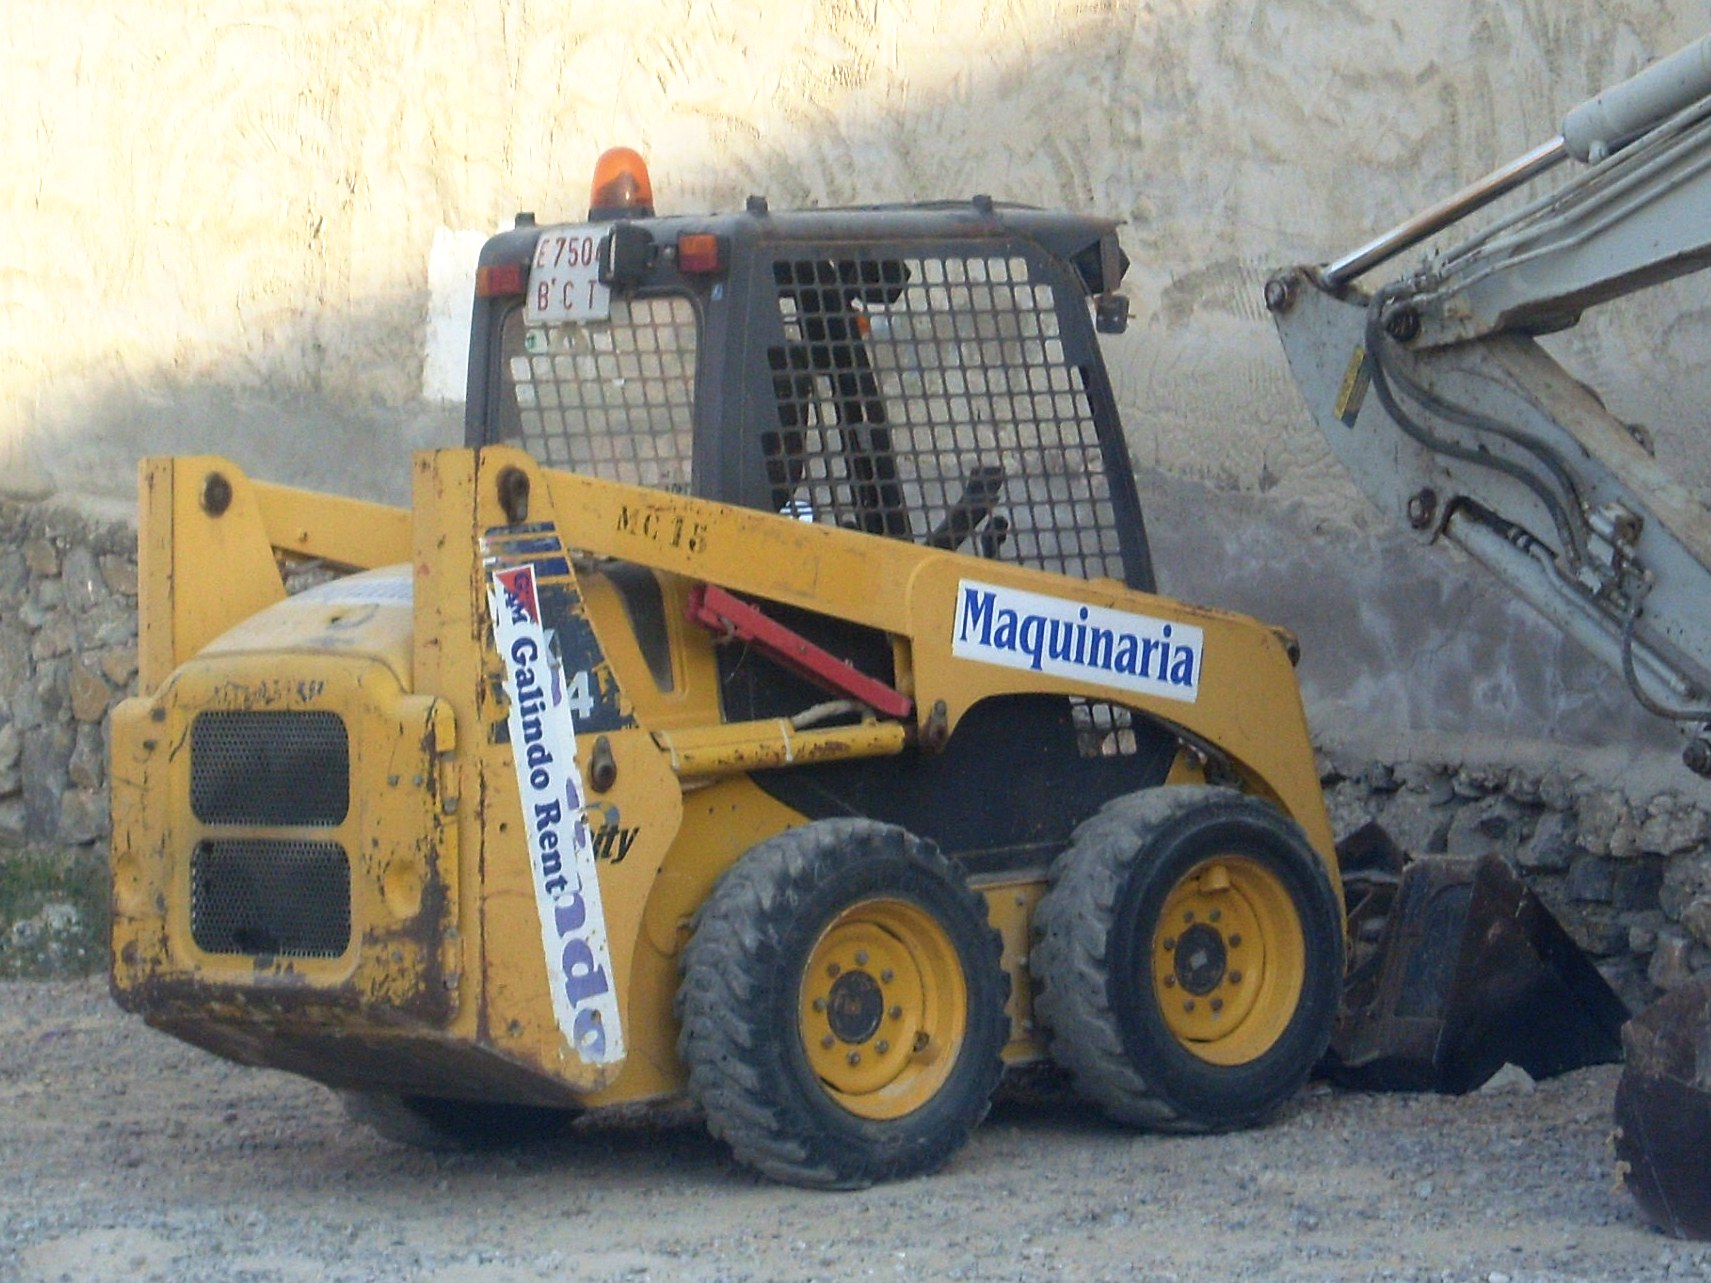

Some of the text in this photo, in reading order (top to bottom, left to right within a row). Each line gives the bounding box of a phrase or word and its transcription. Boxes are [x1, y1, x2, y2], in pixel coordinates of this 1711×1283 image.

[959, 586, 1196, 687] Maquinaria
[511, 636, 553, 791] Galindo
[534, 798, 568, 896] Rent
